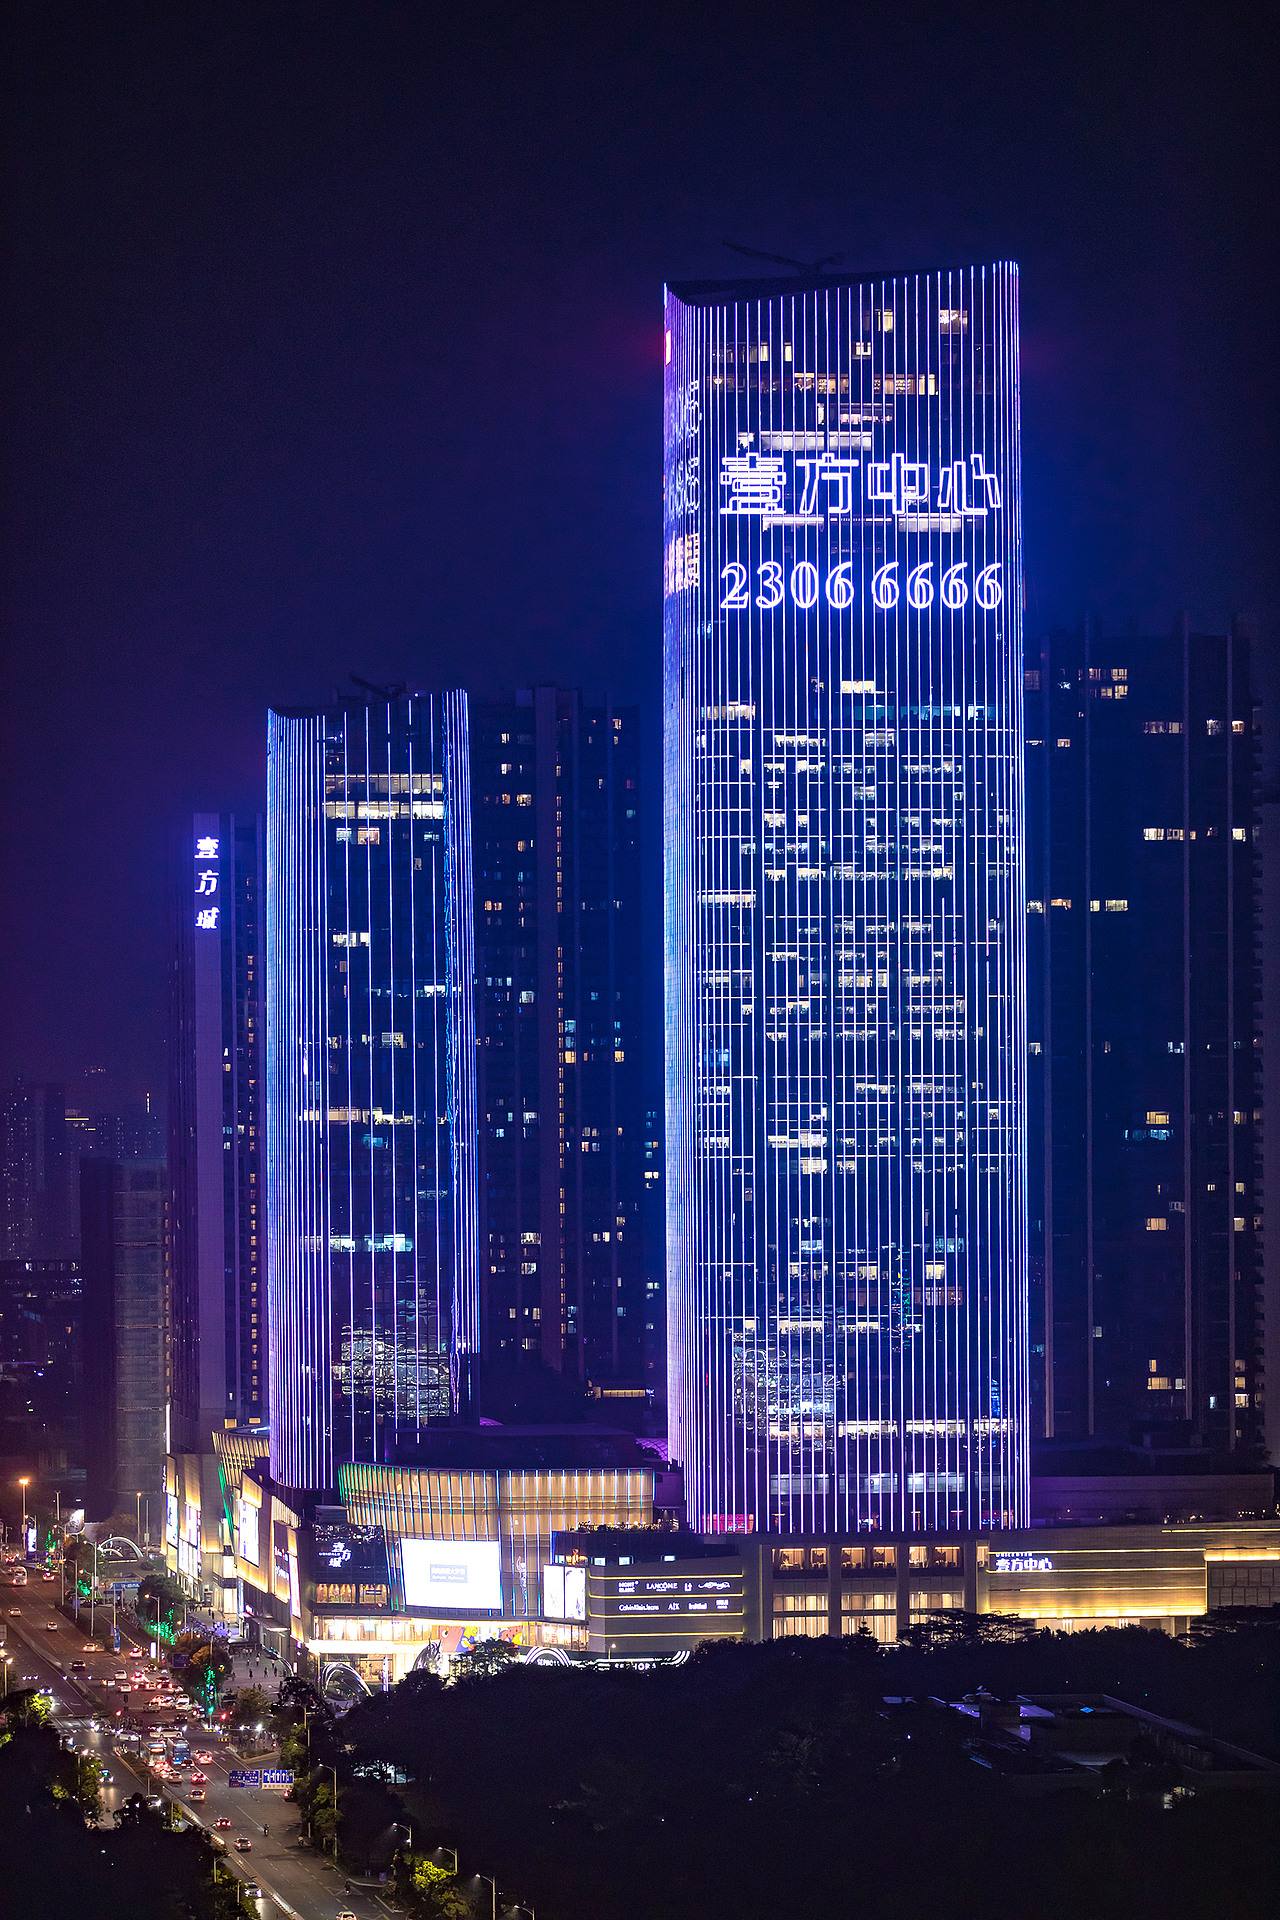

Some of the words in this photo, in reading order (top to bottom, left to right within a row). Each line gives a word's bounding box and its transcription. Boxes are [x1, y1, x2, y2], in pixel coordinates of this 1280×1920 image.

[720, 452, 1002, 515] 壹方中心
[720, 561, 855, 610] 2306
[870, 561, 1002, 610] 6666
[194, 836, 220, 929] 壹方城
[995, 1557, 1053, 1572] 壹方中心
